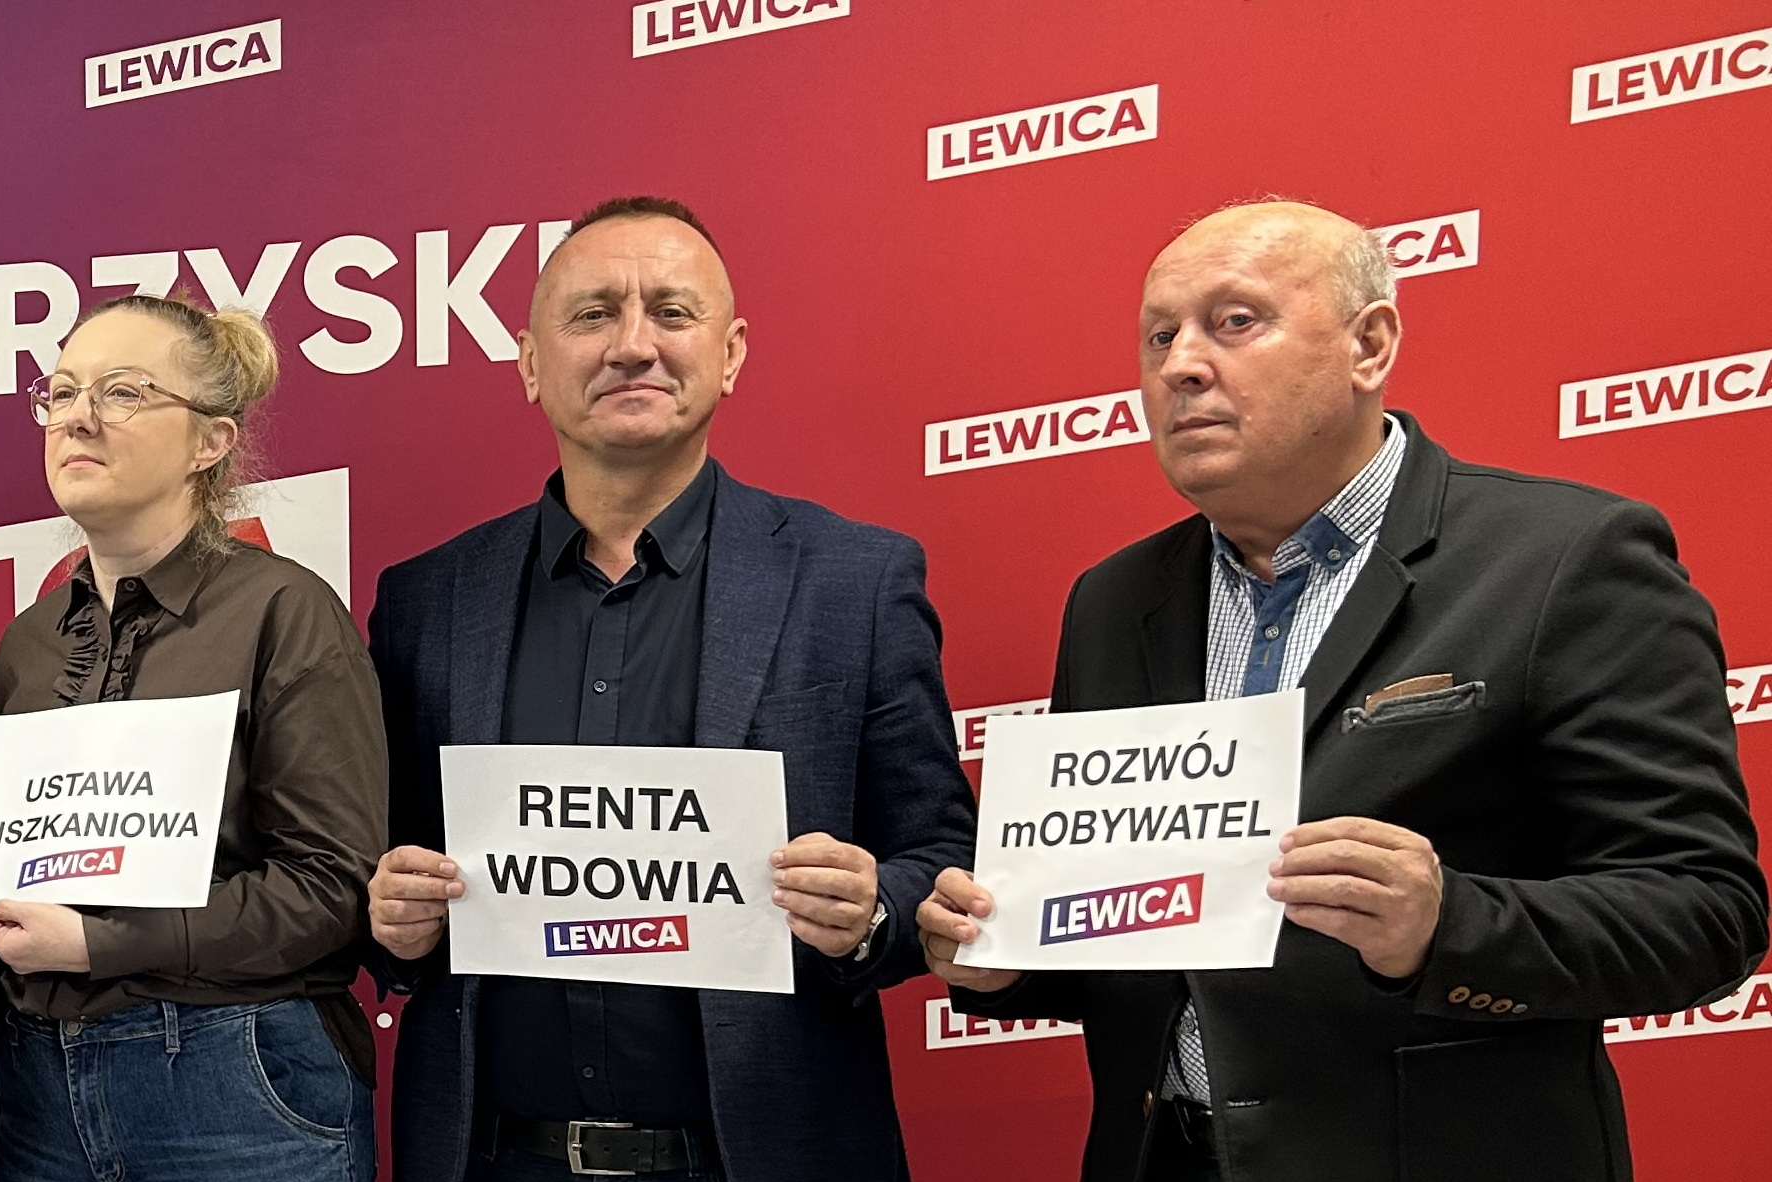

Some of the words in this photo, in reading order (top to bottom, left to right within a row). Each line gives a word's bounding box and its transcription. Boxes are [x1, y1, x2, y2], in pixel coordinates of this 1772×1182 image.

[97, 31, 272, 97] LEWICA
[1588, 40, 1772, 111] LEWIC
[942, 98, 1145, 168] LEWICA
[940, 401, 1139, 464] LEWICA
[1050, 730, 1237, 787] ROZWÓJ
[26, 771, 153, 802] USTAWA
[519, 784, 710, 832] RENTA
[1001, 800, 1271, 848] mOBYWATEL
[22, 851, 116, 883] LEWICA
[486, 854, 745, 904] WDOWIA
[552, 921, 682, 951] LEWICA
[1049, 883, 1192, 937] LEWICA
